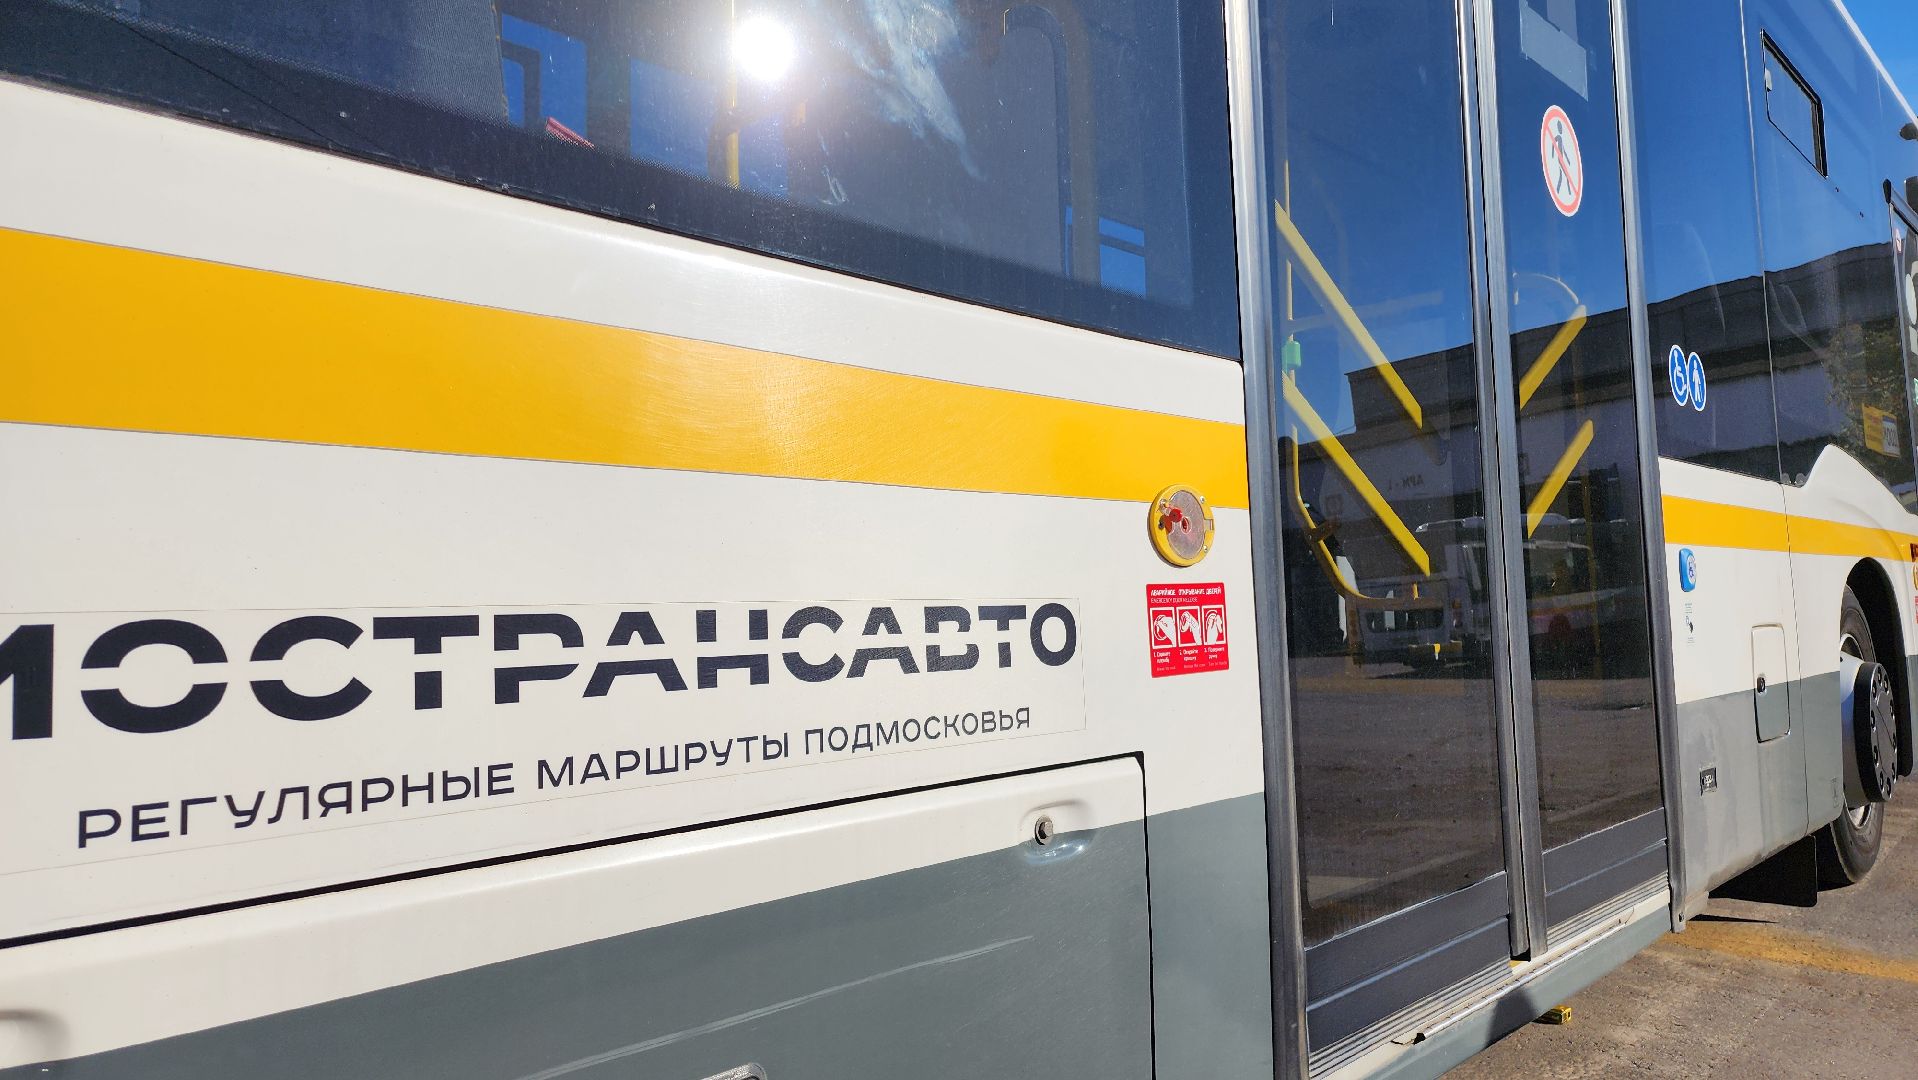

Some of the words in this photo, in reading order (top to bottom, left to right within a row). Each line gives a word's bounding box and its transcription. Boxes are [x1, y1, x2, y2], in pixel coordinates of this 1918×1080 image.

[79, 762, 515, 848] РЕГУЛЯРНЫЕ
[537, 732, 789, 790] МАРШРУТЫ
[805, 706, 1030, 755] ПОДМОСКОВЬЯ
